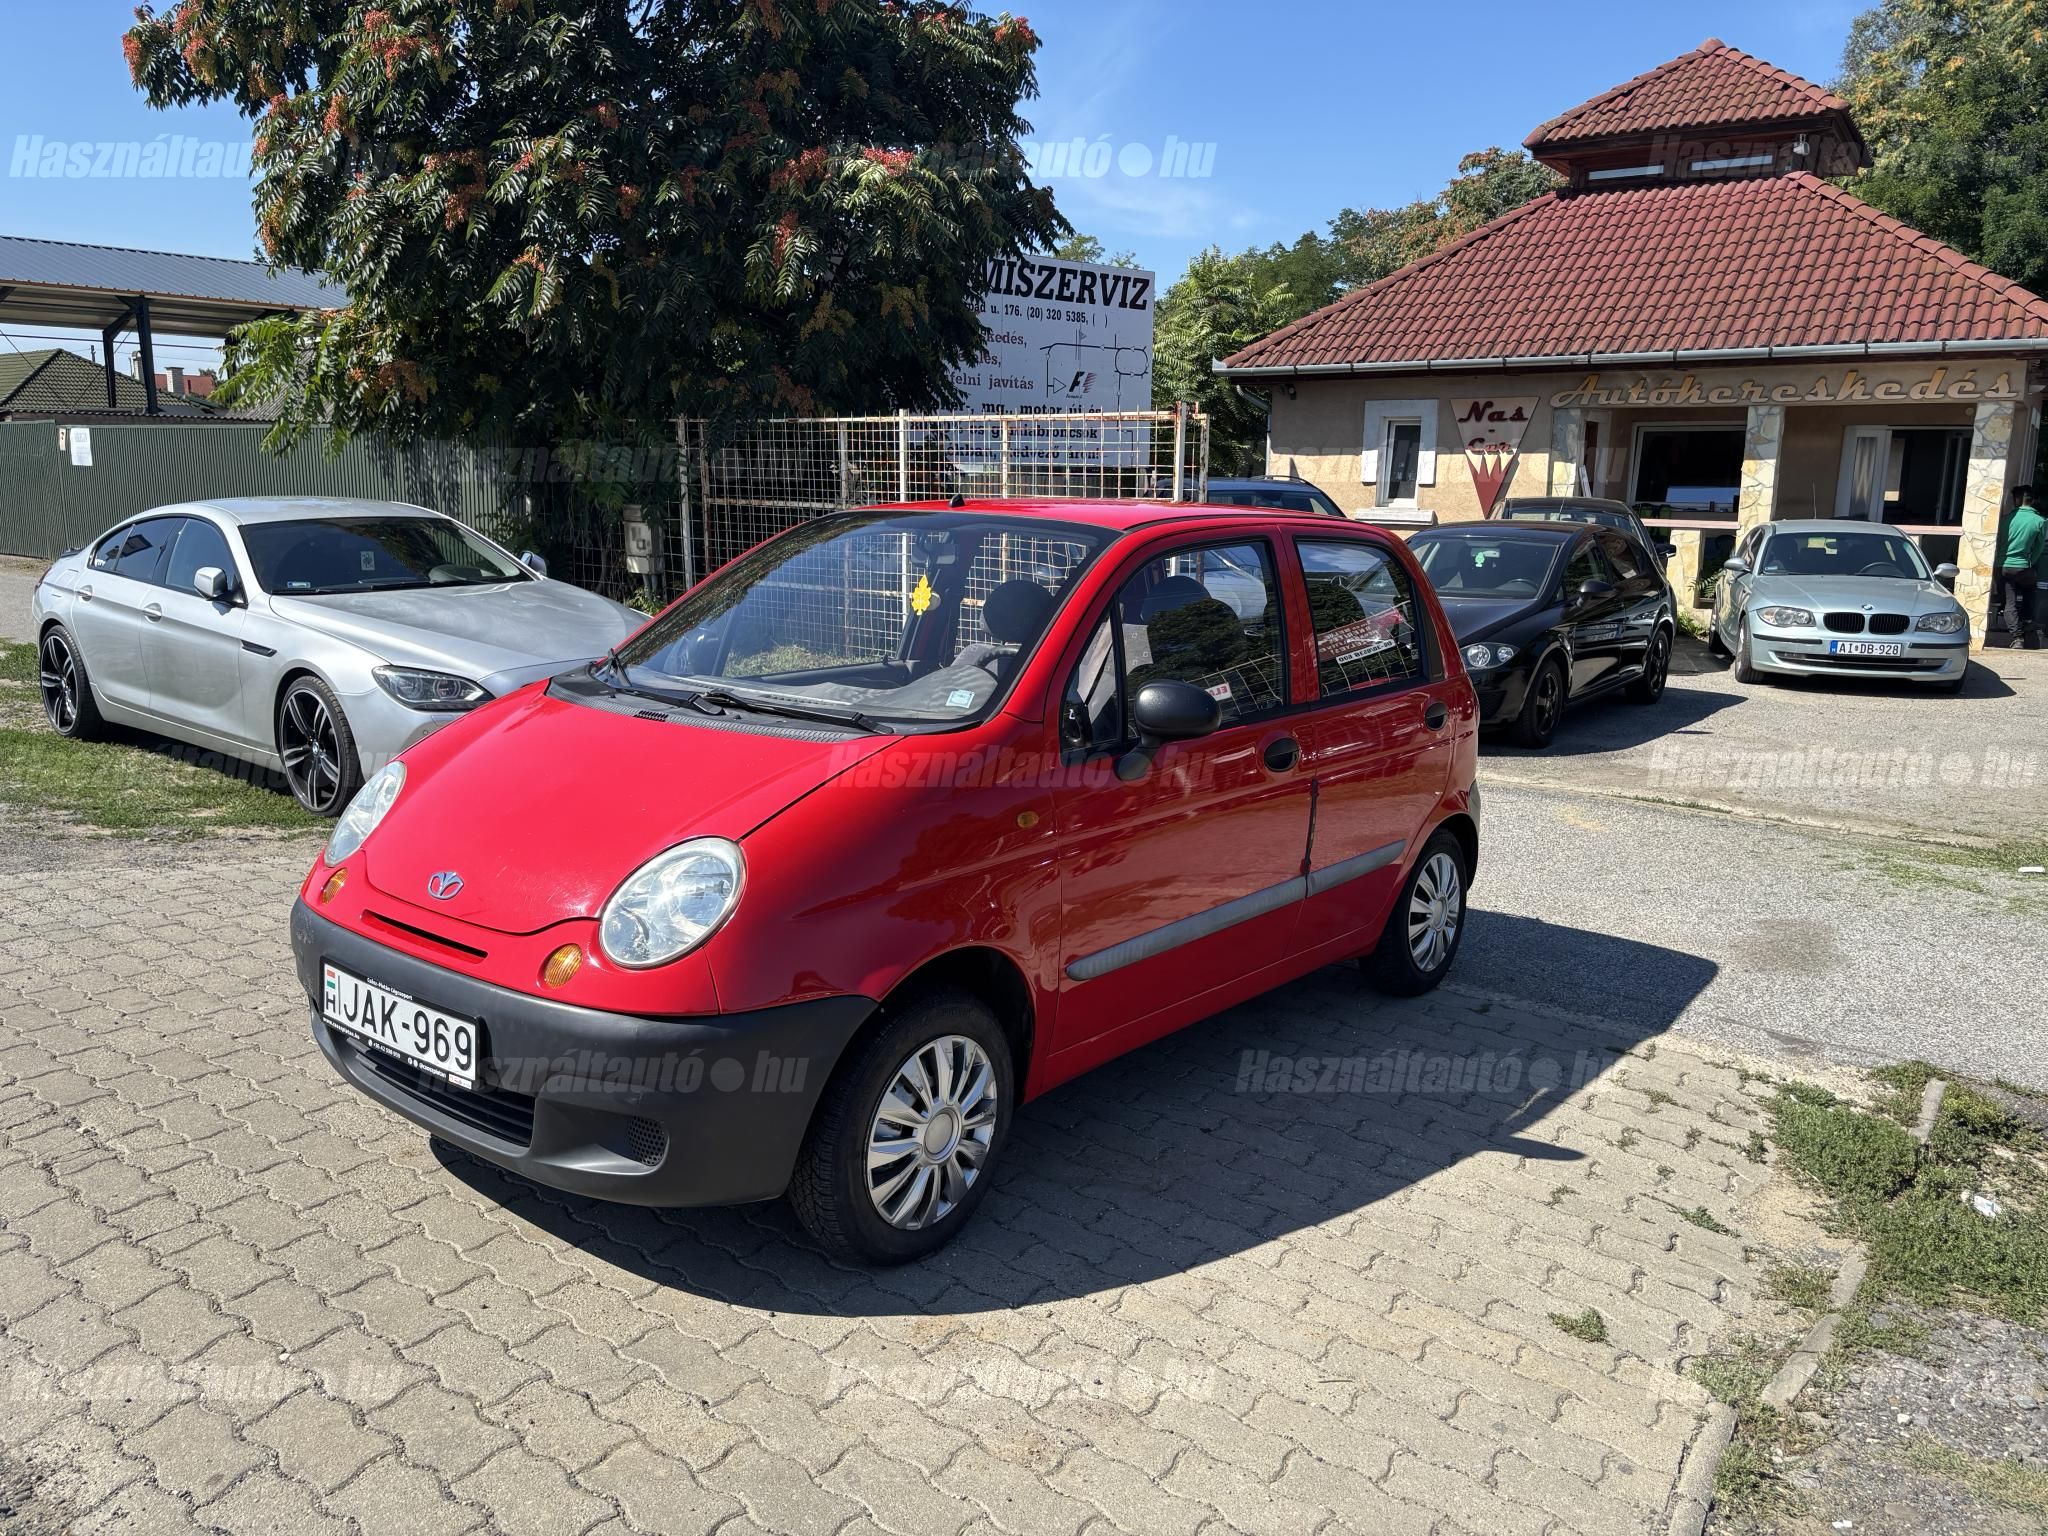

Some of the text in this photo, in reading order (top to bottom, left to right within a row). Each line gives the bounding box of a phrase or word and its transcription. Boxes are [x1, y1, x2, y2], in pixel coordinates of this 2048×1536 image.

[983, 257, 1150, 310] MISZERVIZ
[1004, 304, 1022, 317] 176.
[1026, 306, 1043, 321] (20)
[1046, 309, 1062, 321] 320
[1066, 310, 1089, 325] 5385,
[980, 330, 1027, 348] kedés,
[988, 372, 1034, 390] javítás
[1550, 367, 2020, 407] Autókereskedés
[1458, 401, 1528, 422] Nas
[991, 424, 1098, 439] gmiabroncsok
[343, 983, 472, 1071] JAK-969
